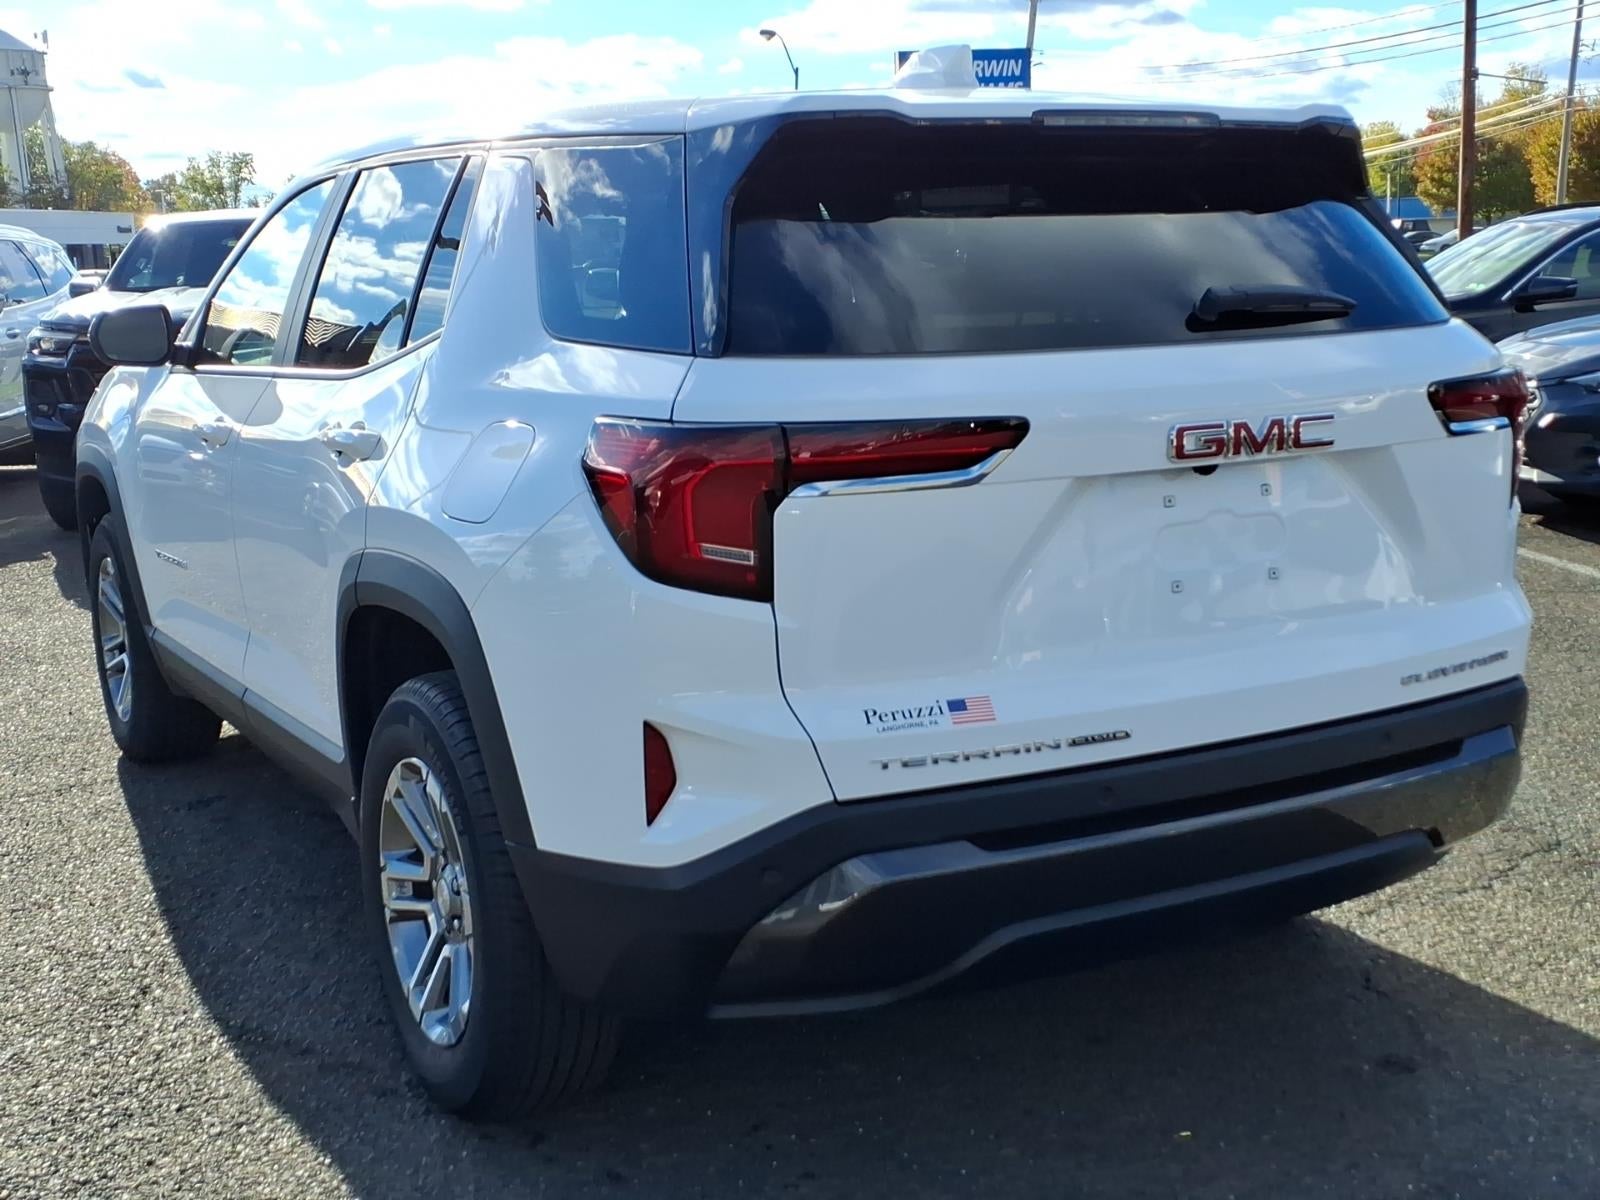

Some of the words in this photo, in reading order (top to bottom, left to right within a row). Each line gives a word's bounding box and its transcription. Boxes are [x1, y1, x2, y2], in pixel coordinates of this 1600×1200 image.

[1168, 412, 1335, 463] GMC
[862, 699, 944, 725] Peruzzi
[928, 719, 939, 727] PA
[870, 737, 1062, 770] TERRAIN
